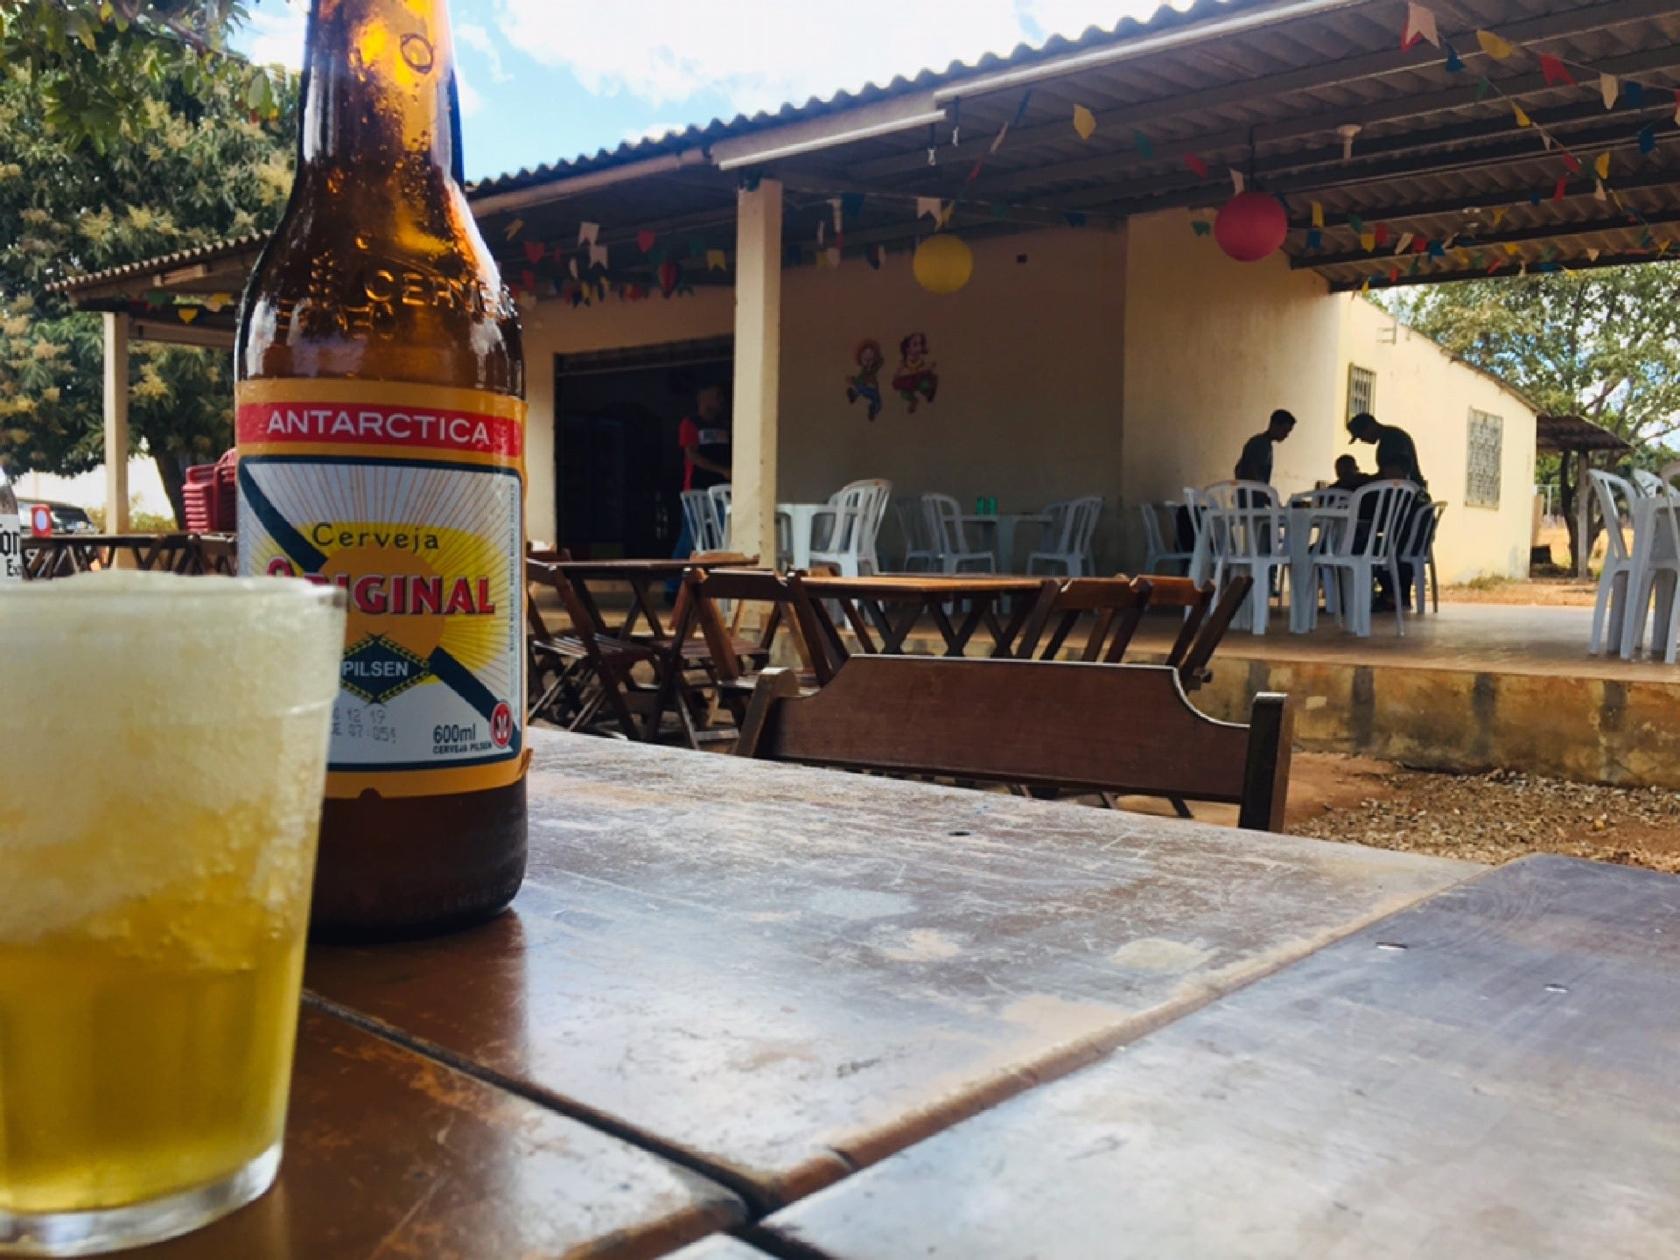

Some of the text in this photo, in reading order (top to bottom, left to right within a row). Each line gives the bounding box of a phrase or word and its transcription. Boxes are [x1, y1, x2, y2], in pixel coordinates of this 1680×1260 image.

[266, 409, 490, 445] ANTARCTICA
[311, 521, 439, 553] Cerveja
[267, 557, 496, 615] GINAL
[342, 660, 409, 677] PILSEN
[433, 723, 476, 744] 600ml
